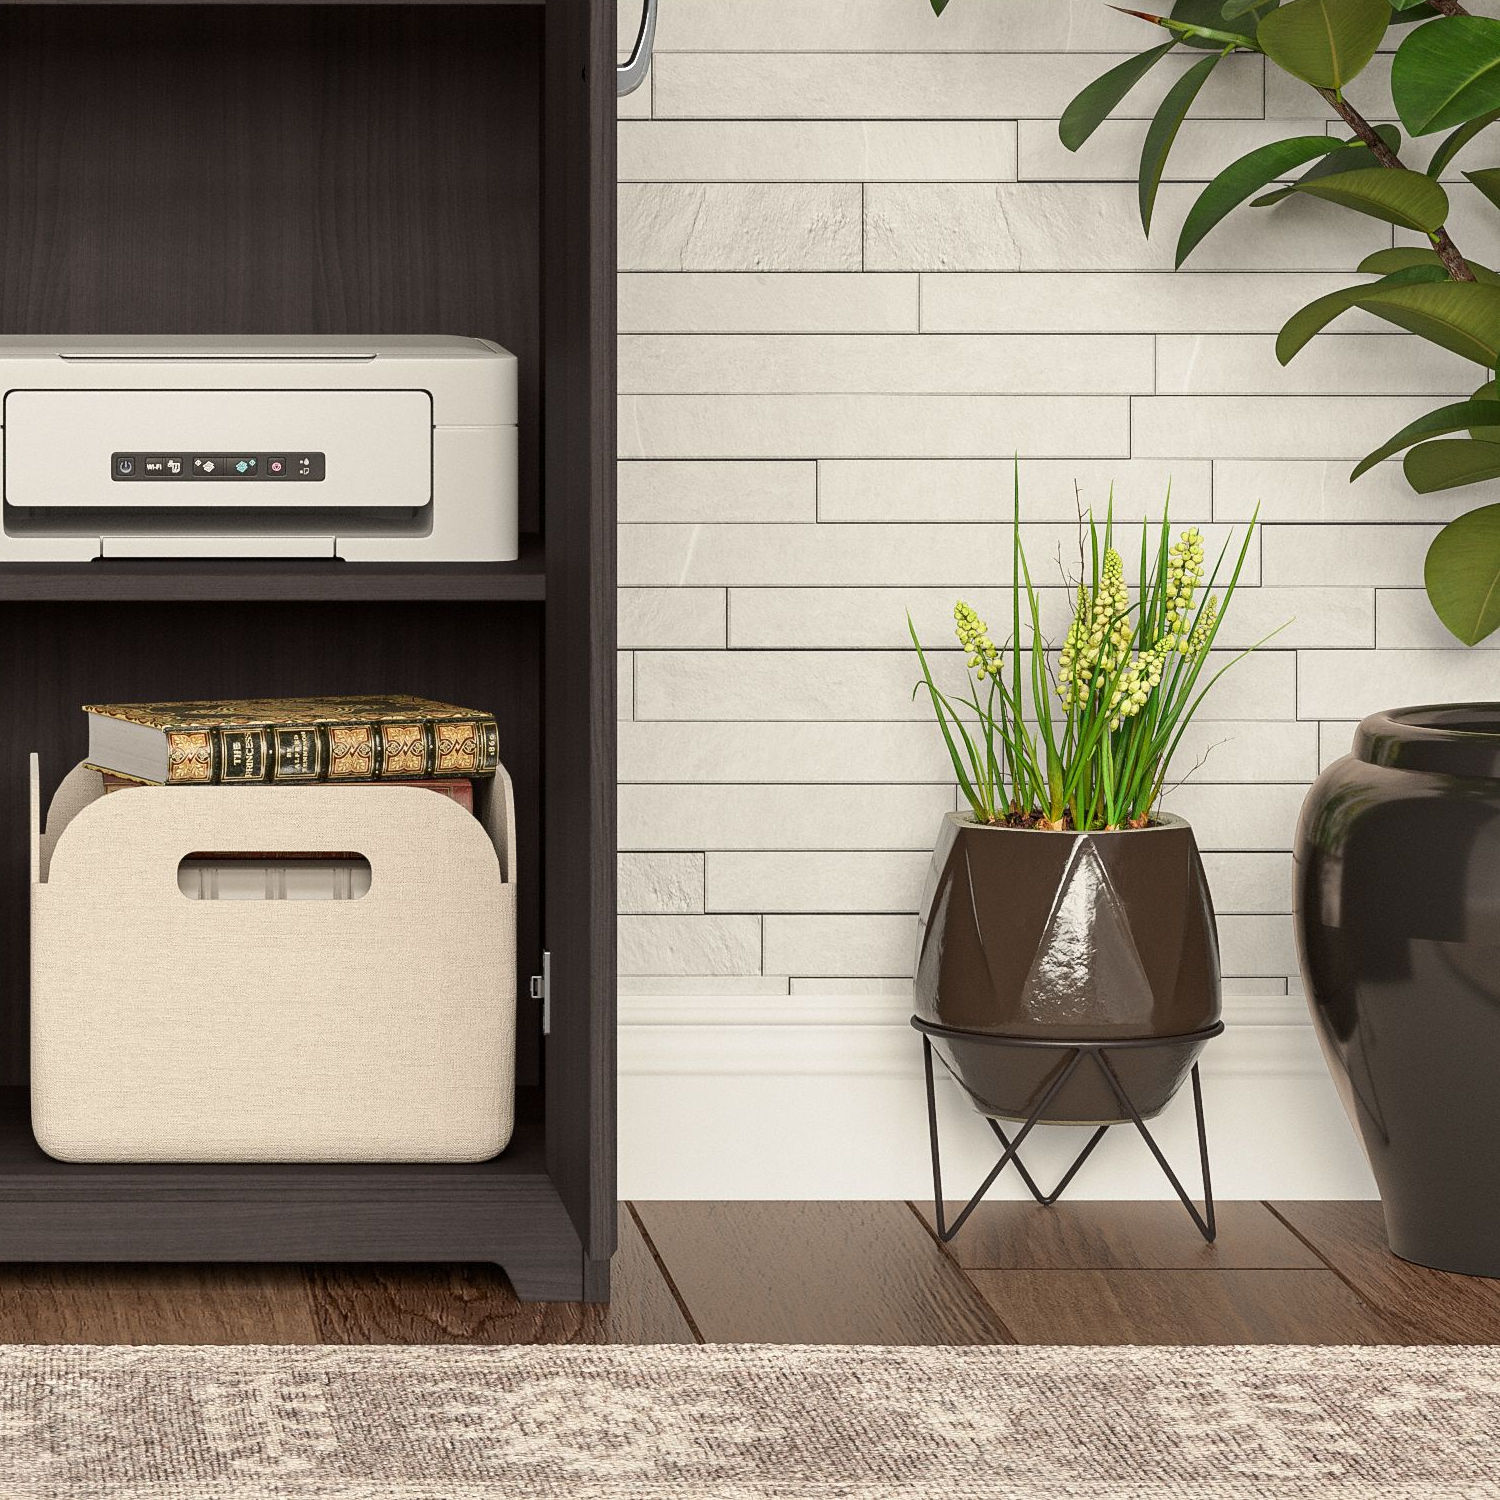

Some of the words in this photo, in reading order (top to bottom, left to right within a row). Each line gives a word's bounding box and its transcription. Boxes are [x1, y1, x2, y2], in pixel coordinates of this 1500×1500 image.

[232, 741, 242, 766] THE
[244, 731, 254, 778] PRINCESS
[293, 733, 301, 770] ALFRED
